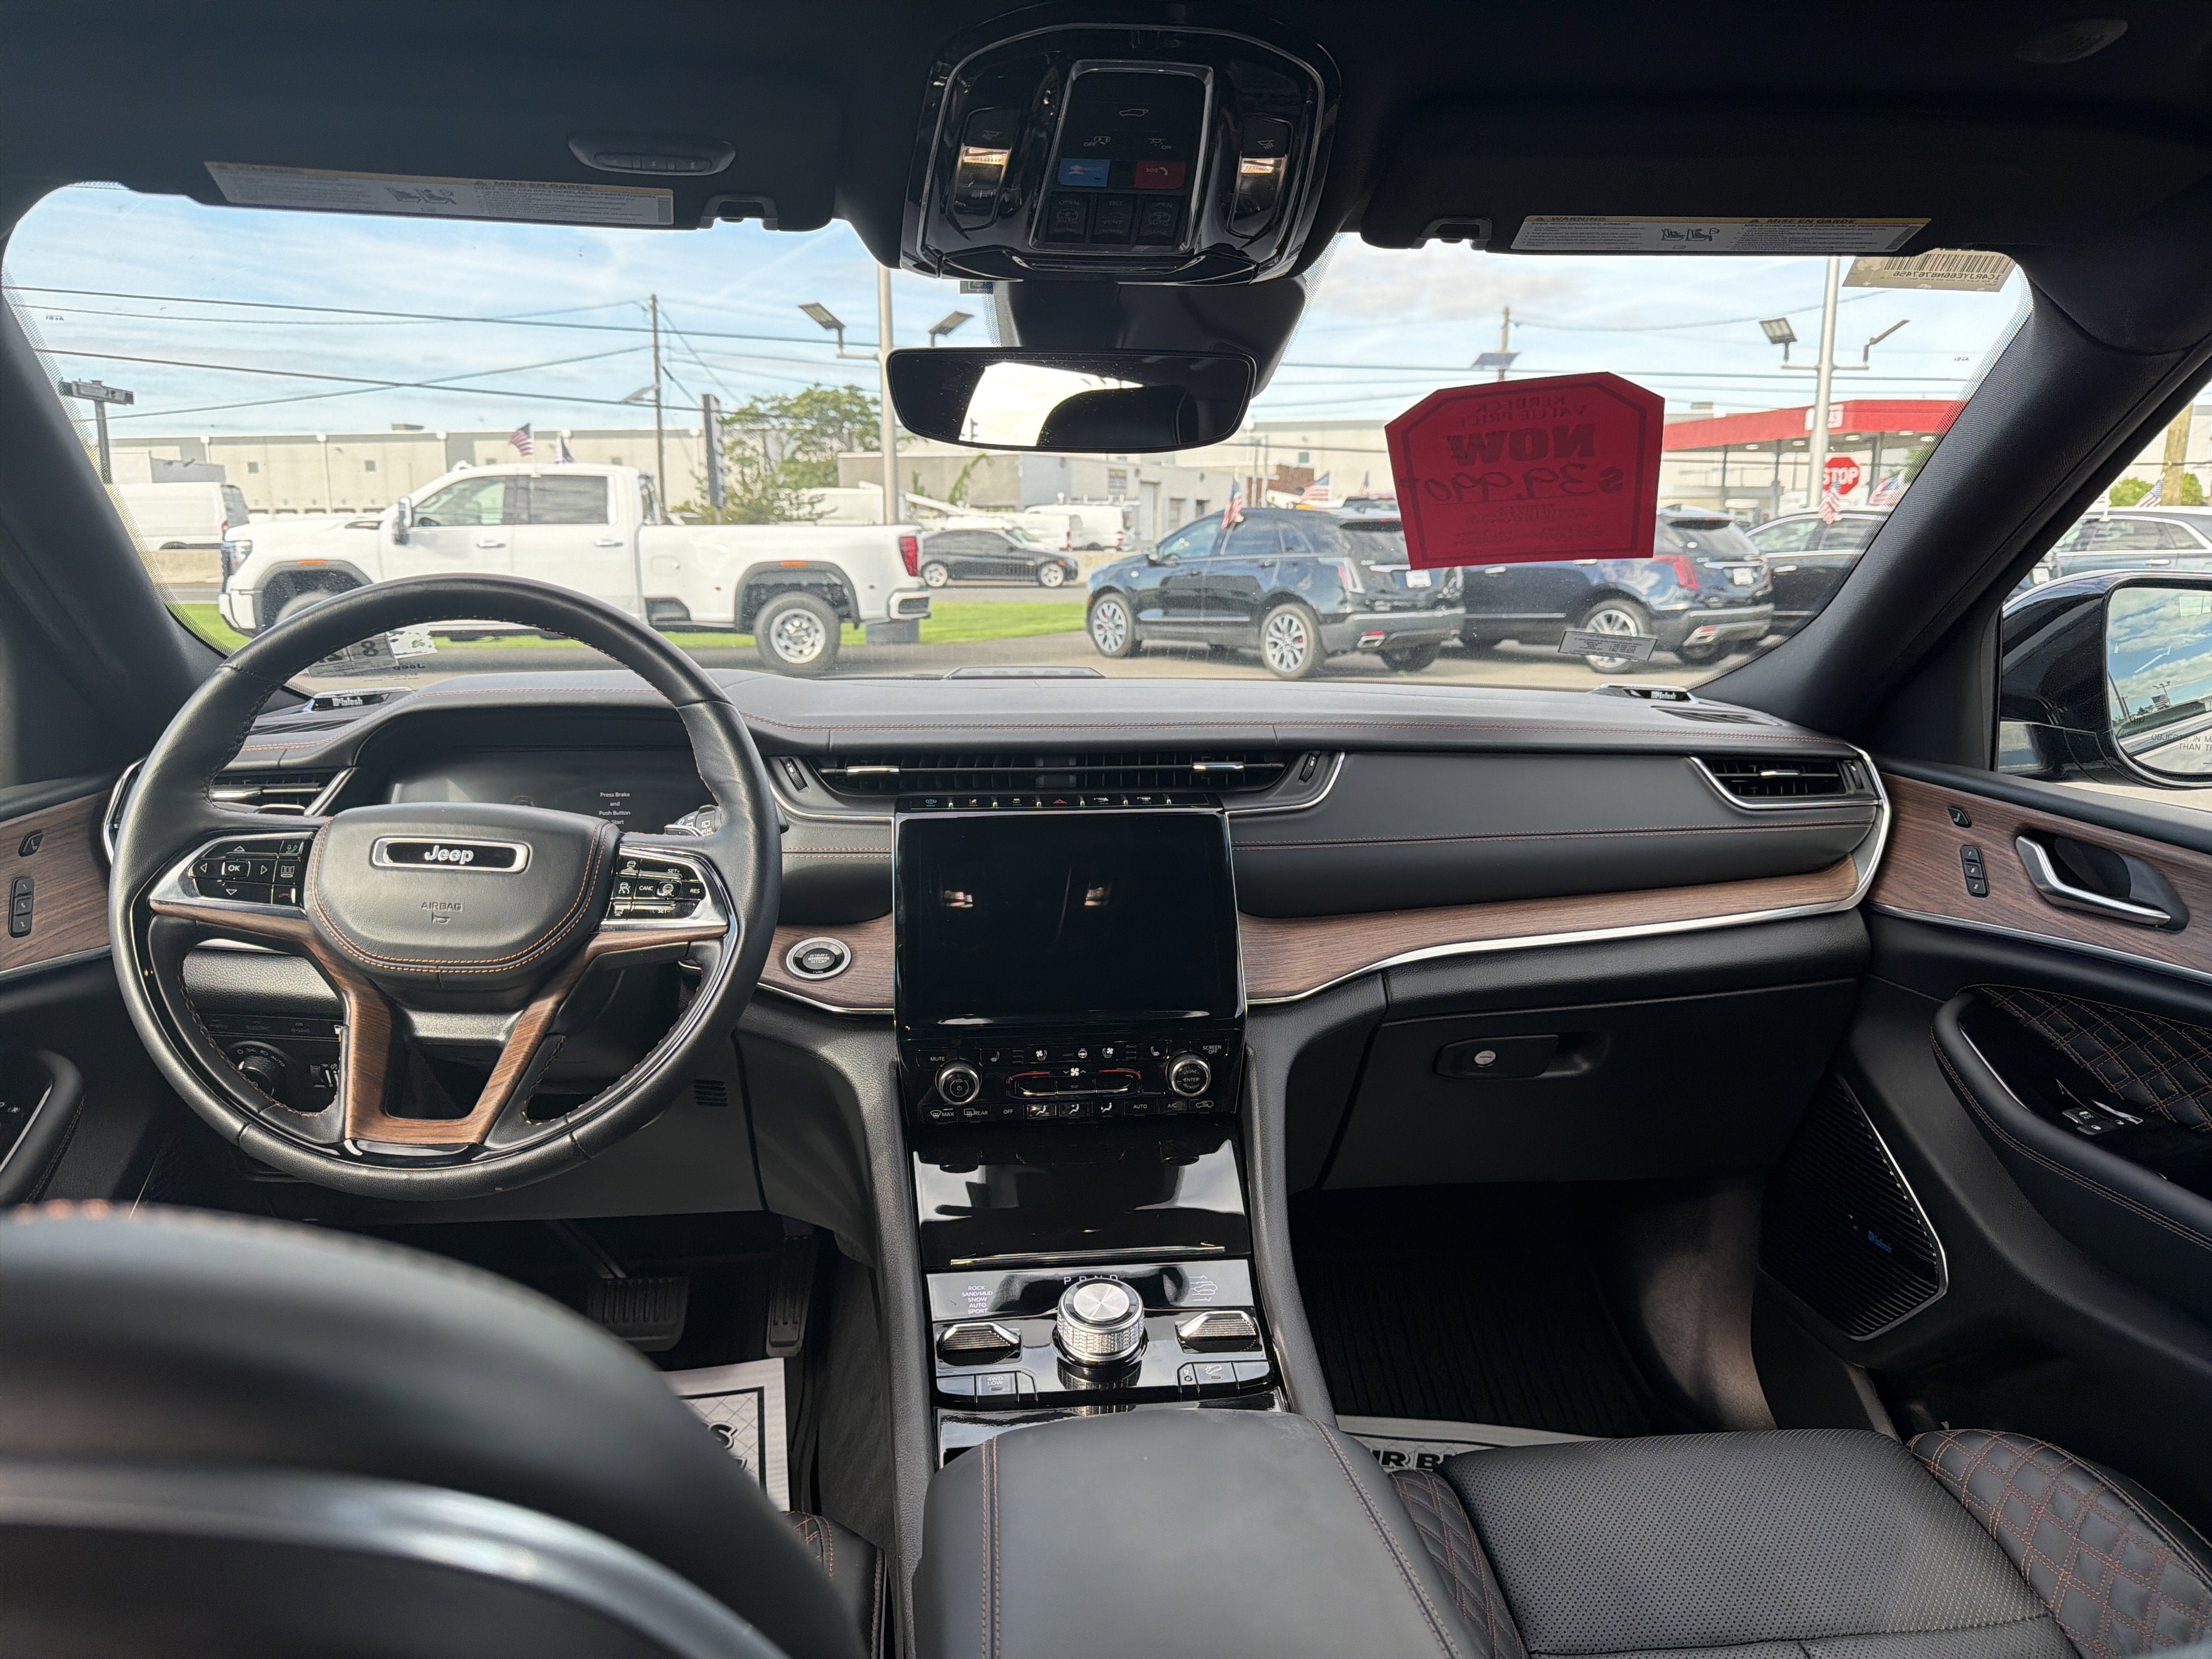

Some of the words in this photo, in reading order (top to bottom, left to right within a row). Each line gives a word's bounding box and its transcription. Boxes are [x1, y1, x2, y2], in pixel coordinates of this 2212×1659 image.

[1823, 467, 1859, 485] STOP
[424, 845, 475, 865] Jeep
[421, 901, 462, 912] AIRBAG
[1064, 1277, 1071, 1285] P
